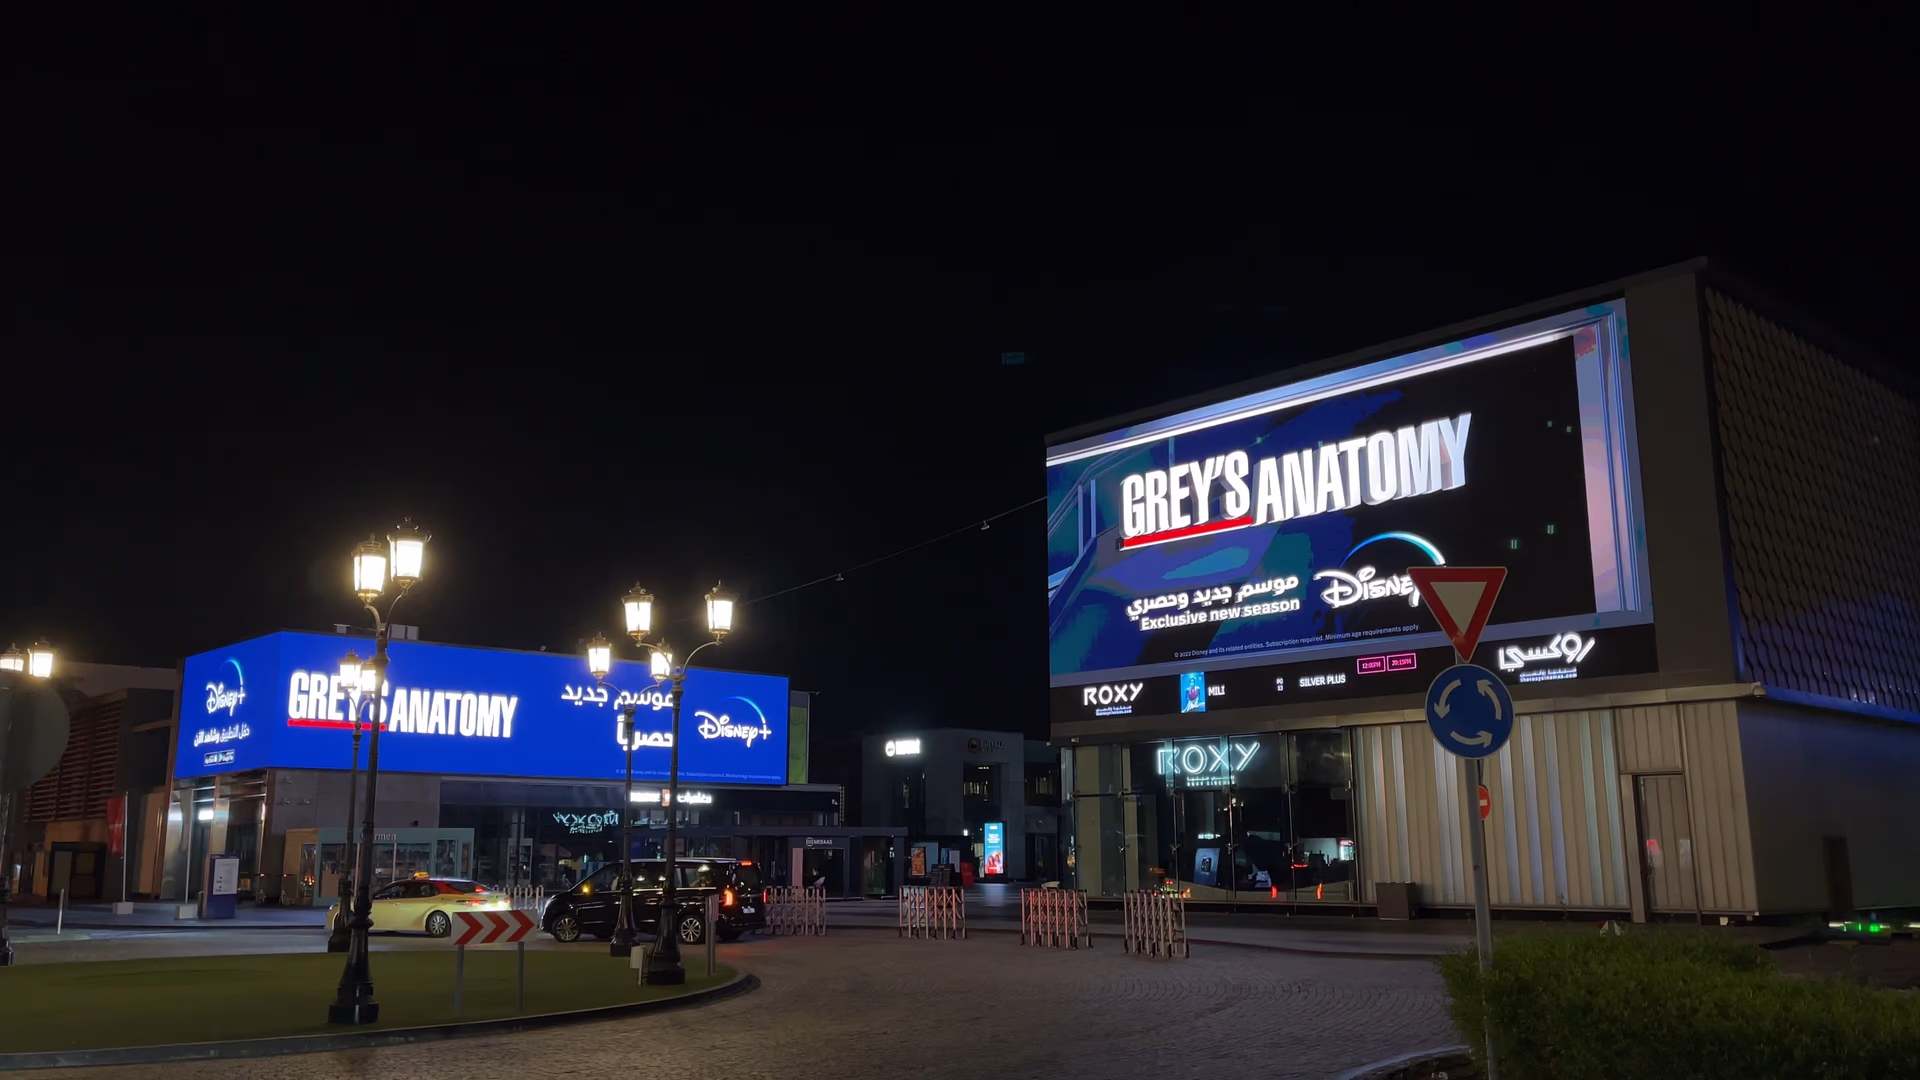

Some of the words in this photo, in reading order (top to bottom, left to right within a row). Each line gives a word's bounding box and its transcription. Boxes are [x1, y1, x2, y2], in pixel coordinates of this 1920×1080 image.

[1119, 450, 1250, 540] GREY'S
[1251, 412, 1472, 527] ANATOMY
[1192, 585, 1232, 607] جديد
[1235, 575, 1299, 603] موسم
[1126, 592, 1189, 621] وحصري
[1140, 610, 1207, 631] Exclusive
[1210, 606, 1240, 621] new
[1240, 598, 1300, 616] season
[1191, 648, 1208, 656] Disney
[1265, 638, 1299, 648] Subscription
[1362, 626, 1402, 637] requirements
[1083, 682, 1144, 706] ROXY
[1208, 685, 1226, 697] MILI
[1299, 676, 1326, 687] SILVER
[1326, 673, 1346, 685] PLUS
[561, 684, 608, 707] جديد
[388, 687, 518, 738] ANATOMY
[1157, 741, 1260, 775] ROXY
